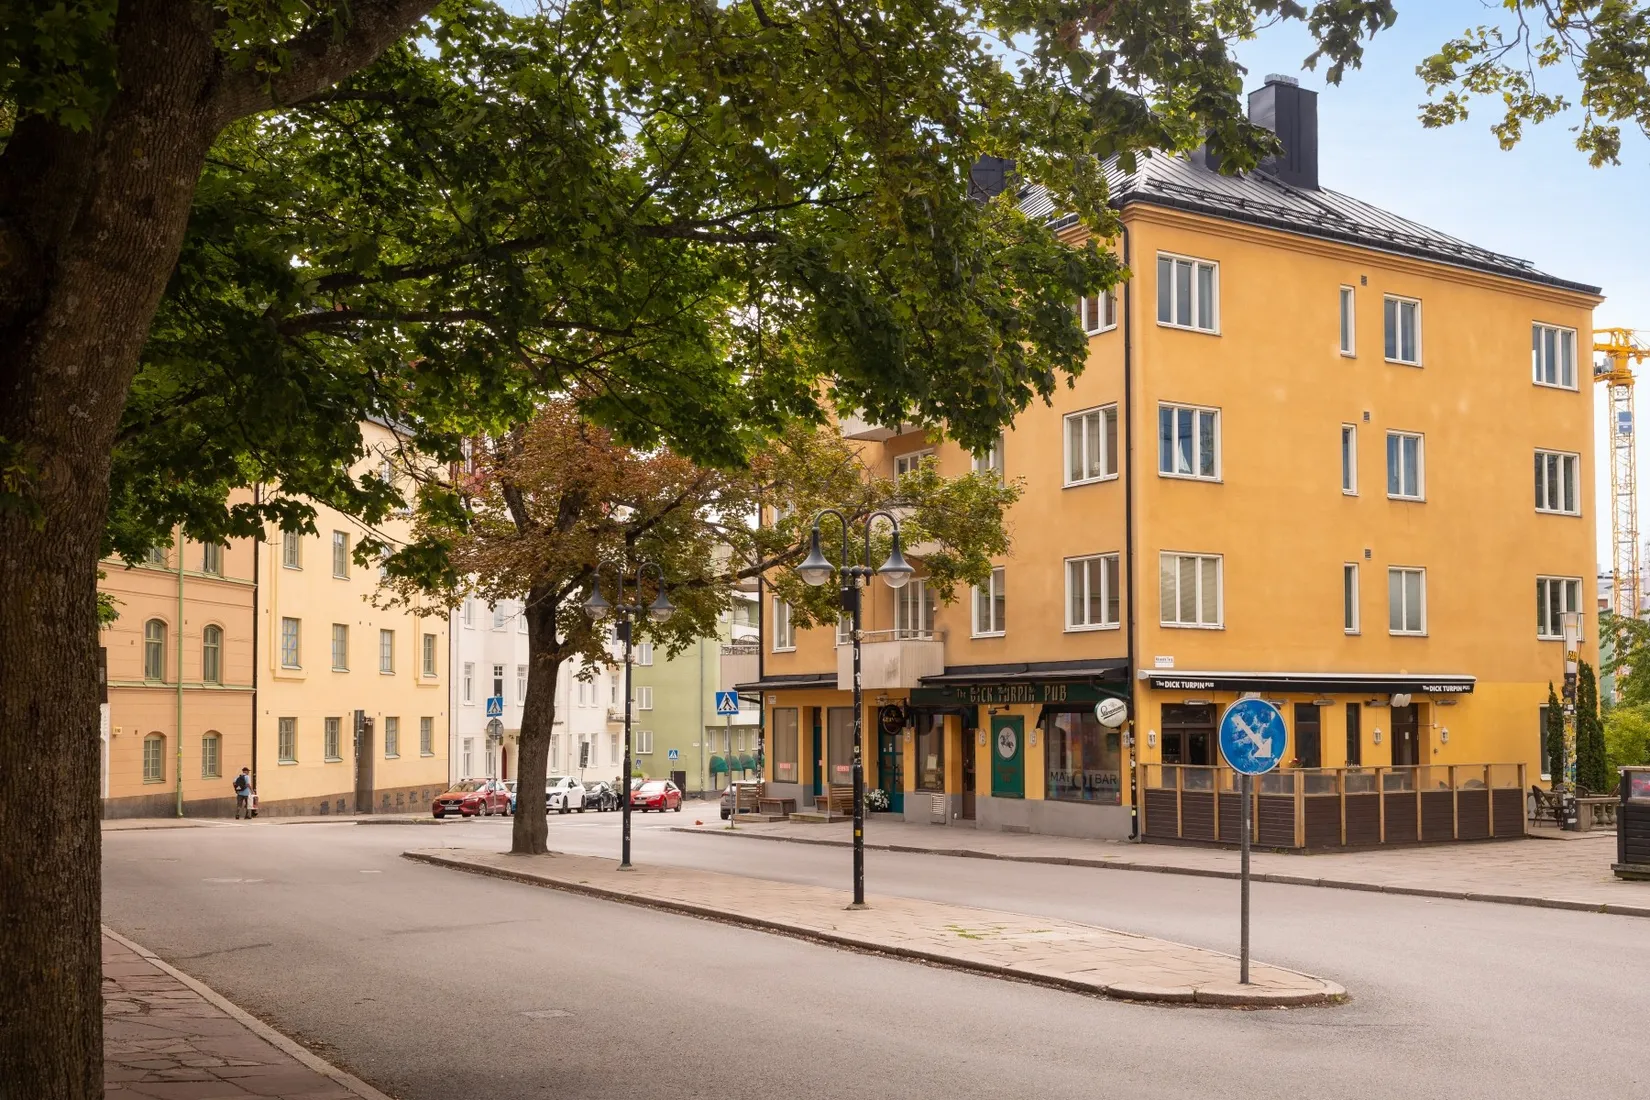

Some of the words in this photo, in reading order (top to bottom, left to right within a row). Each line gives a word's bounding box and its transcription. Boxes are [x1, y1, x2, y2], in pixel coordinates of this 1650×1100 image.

[1181, 681, 1205, 689] TURPIN
[1044, 685, 1067, 701] PUB
[1095, 773, 1117, 784] BAR
